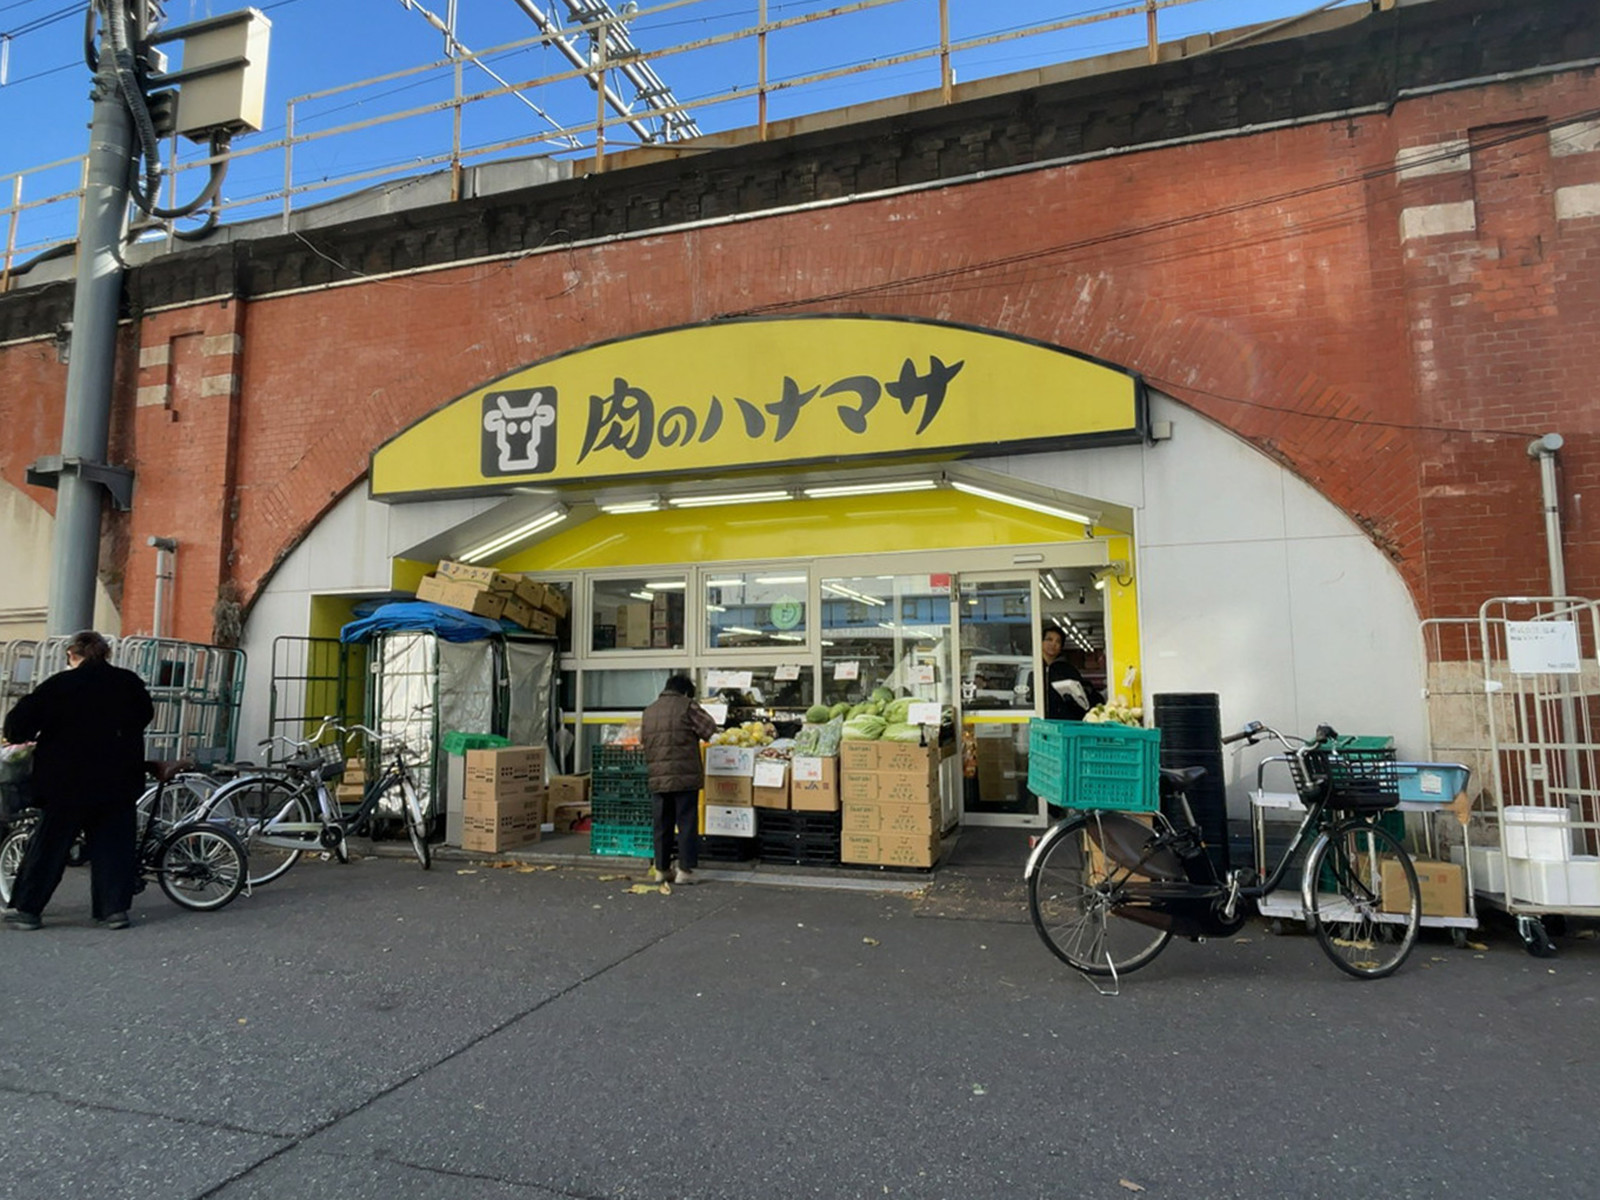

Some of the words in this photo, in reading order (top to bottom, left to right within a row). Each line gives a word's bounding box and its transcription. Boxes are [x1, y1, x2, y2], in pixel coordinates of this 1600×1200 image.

[577, 355, 964, 464] 肉のハナマサ
